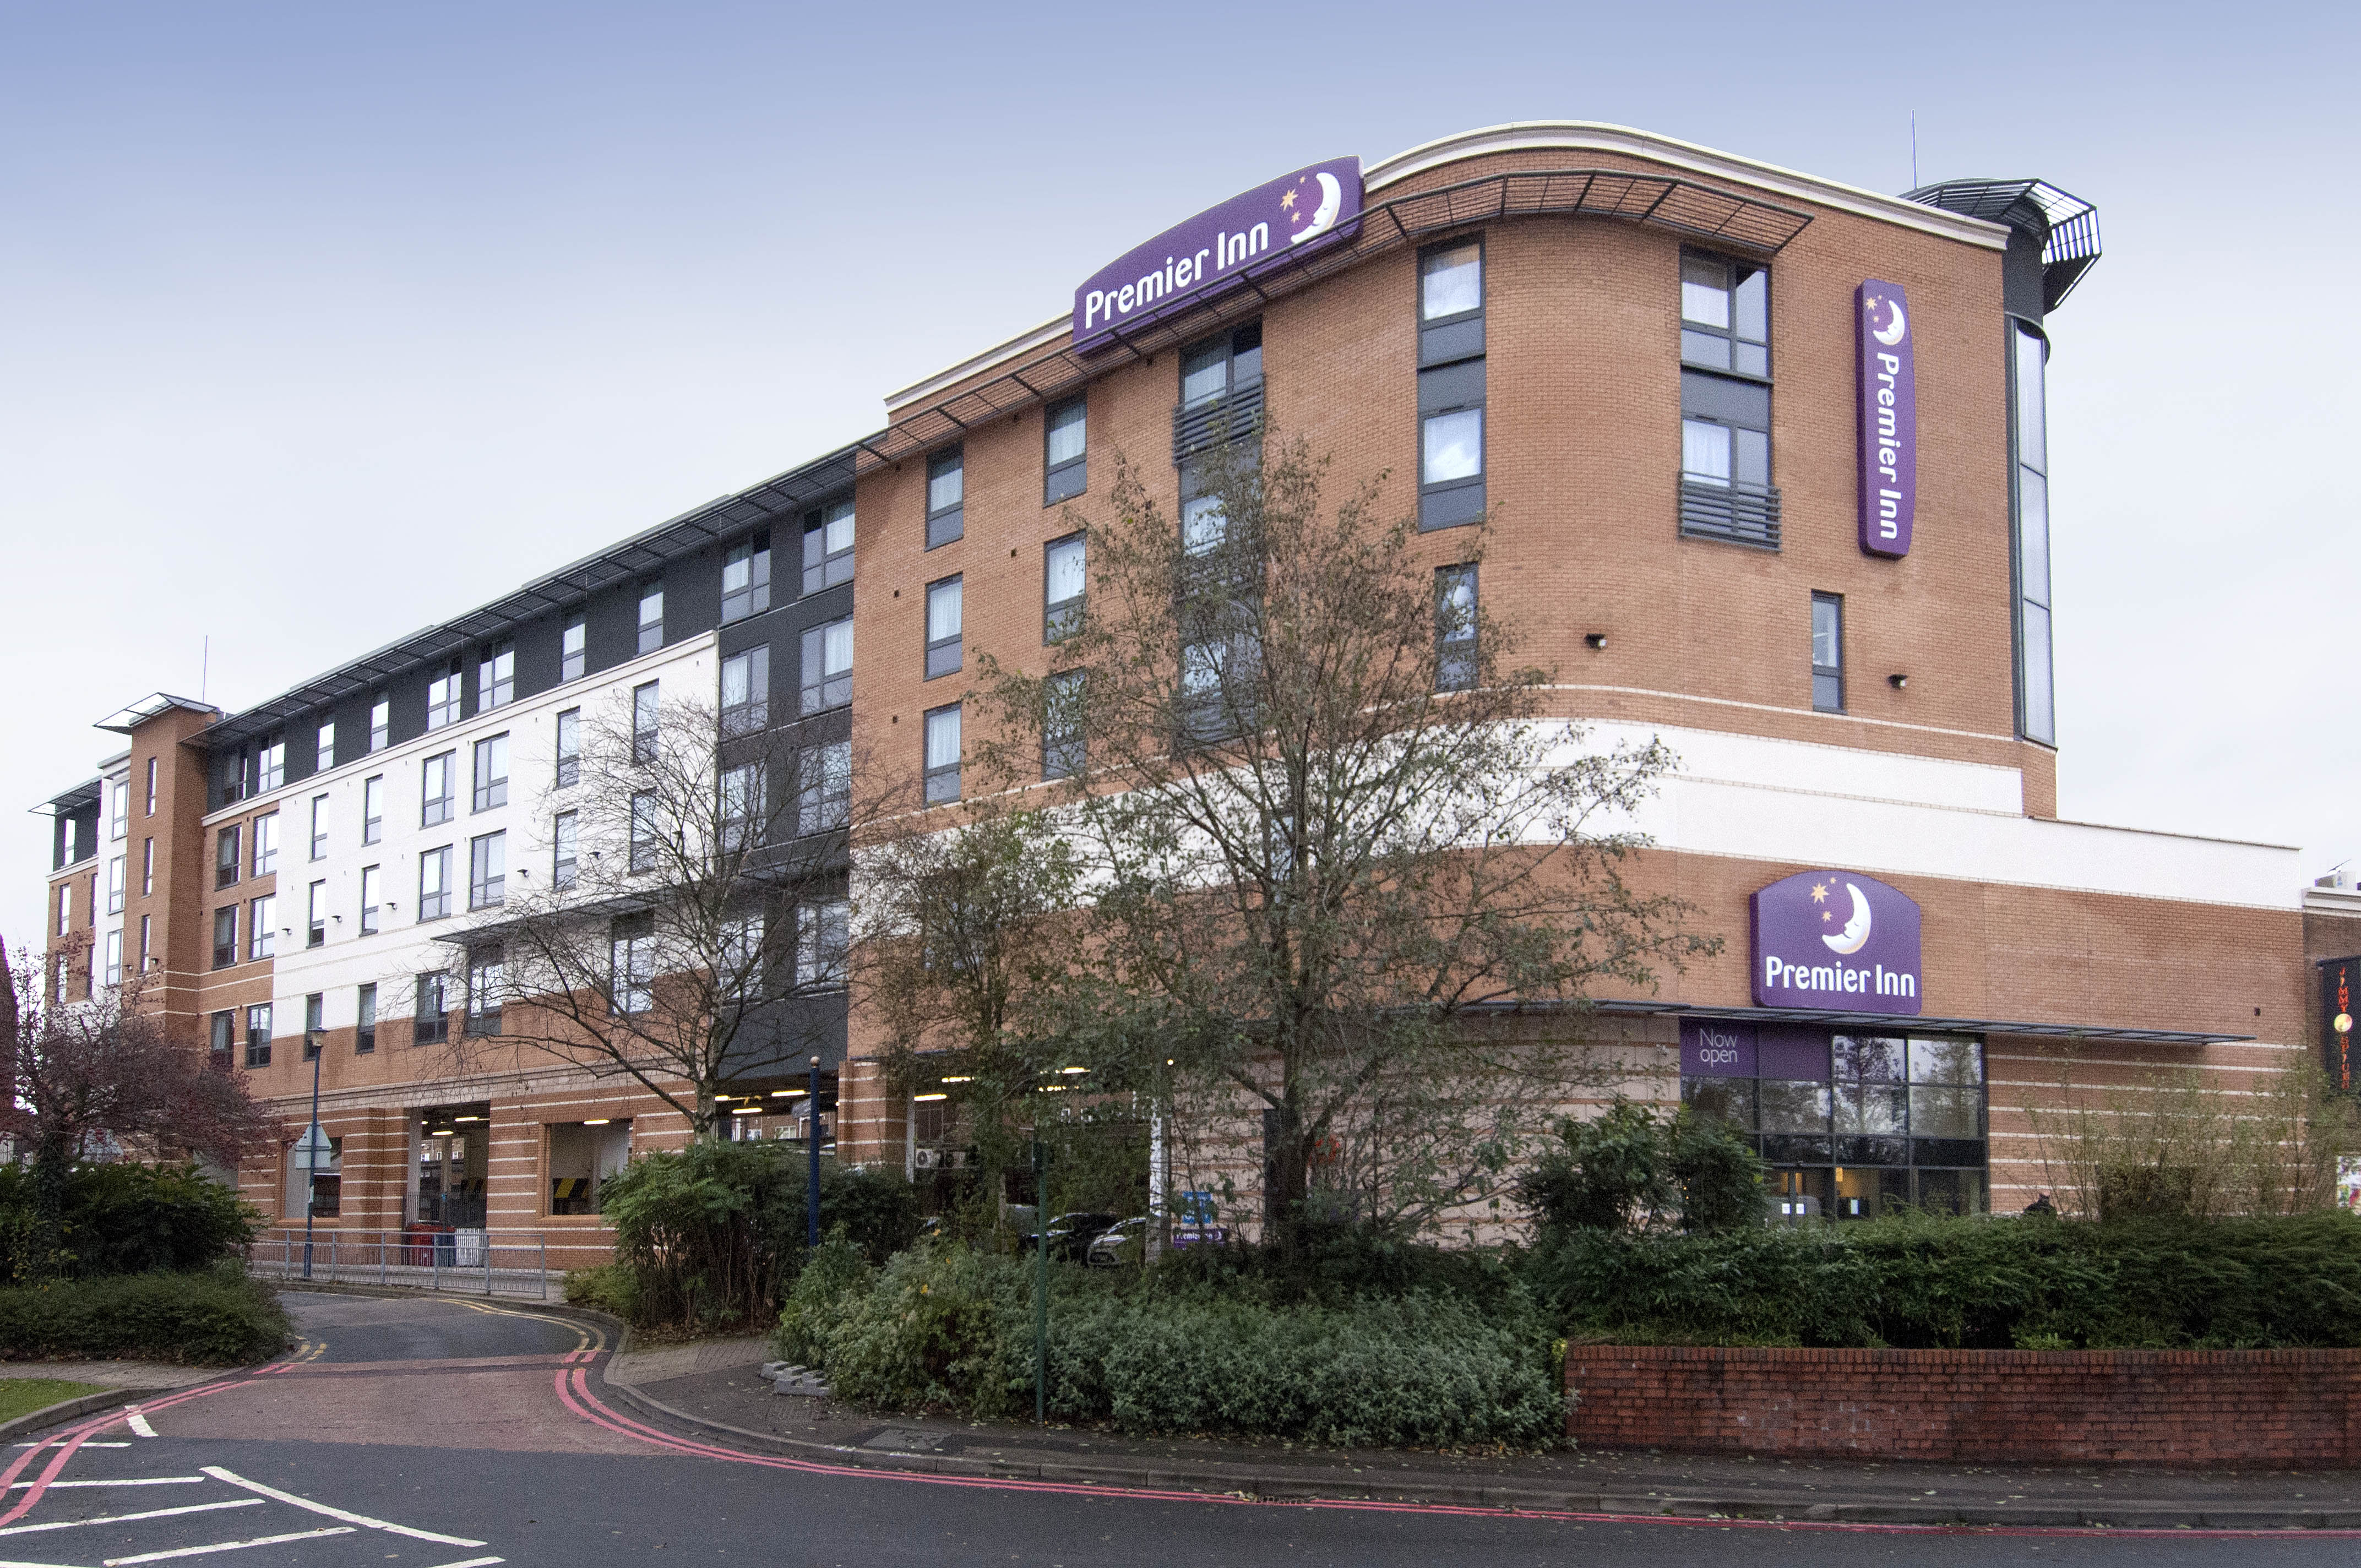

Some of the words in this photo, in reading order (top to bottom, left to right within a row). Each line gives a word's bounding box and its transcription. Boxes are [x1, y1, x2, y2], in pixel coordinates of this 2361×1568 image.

[1085, 248, 1209, 329] Premier
[1217, 221, 1269, 270] Inn
[1876, 352, 1901, 483] Premier
[1879, 489, 1901, 540] Inn
[1766, 956, 1871, 993] Premier
[1876, 965, 1916, 997] Inn
[1700, 1028, 1738, 1047] Now
[1700, 1049, 1738, 1068] open
